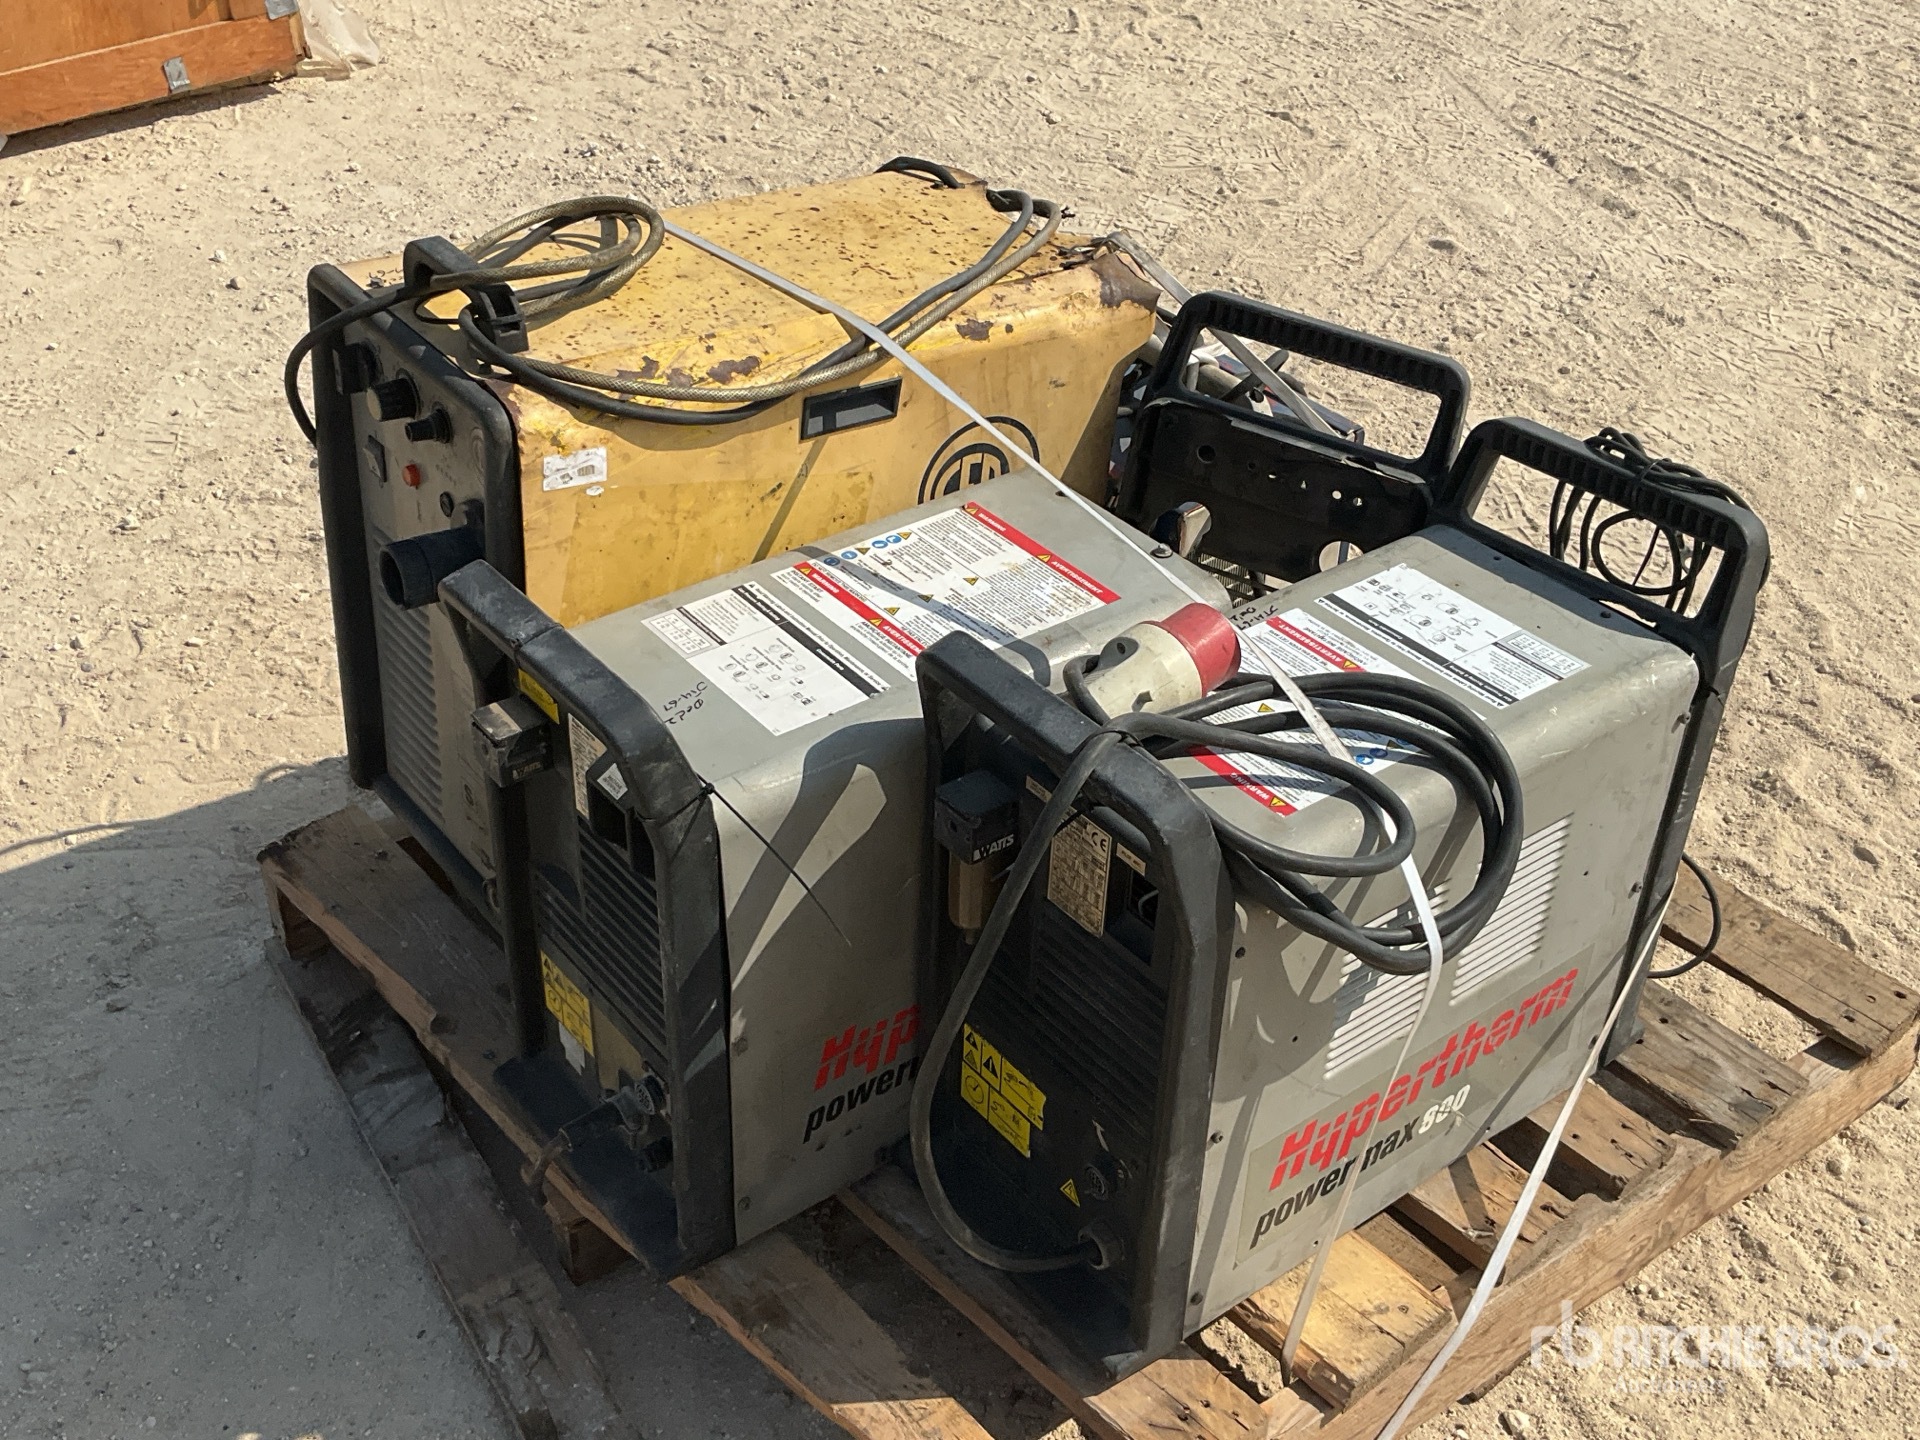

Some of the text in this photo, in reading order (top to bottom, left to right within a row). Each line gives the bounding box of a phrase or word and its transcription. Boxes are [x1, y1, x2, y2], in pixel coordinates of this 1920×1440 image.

[975, 512, 1008, 531] WARNING
[809, 572, 841, 594] WARNING
[1049, 560, 1104, 594] AVERTISSEMENT
[1278, 622, 1343, 662] AVERTISSEMENT
[1230, 772, 1270, 800] WARNING
[973, 834, 1015, 862] WATTS
[1269, 968, 1578, 1191] Hypertherm
